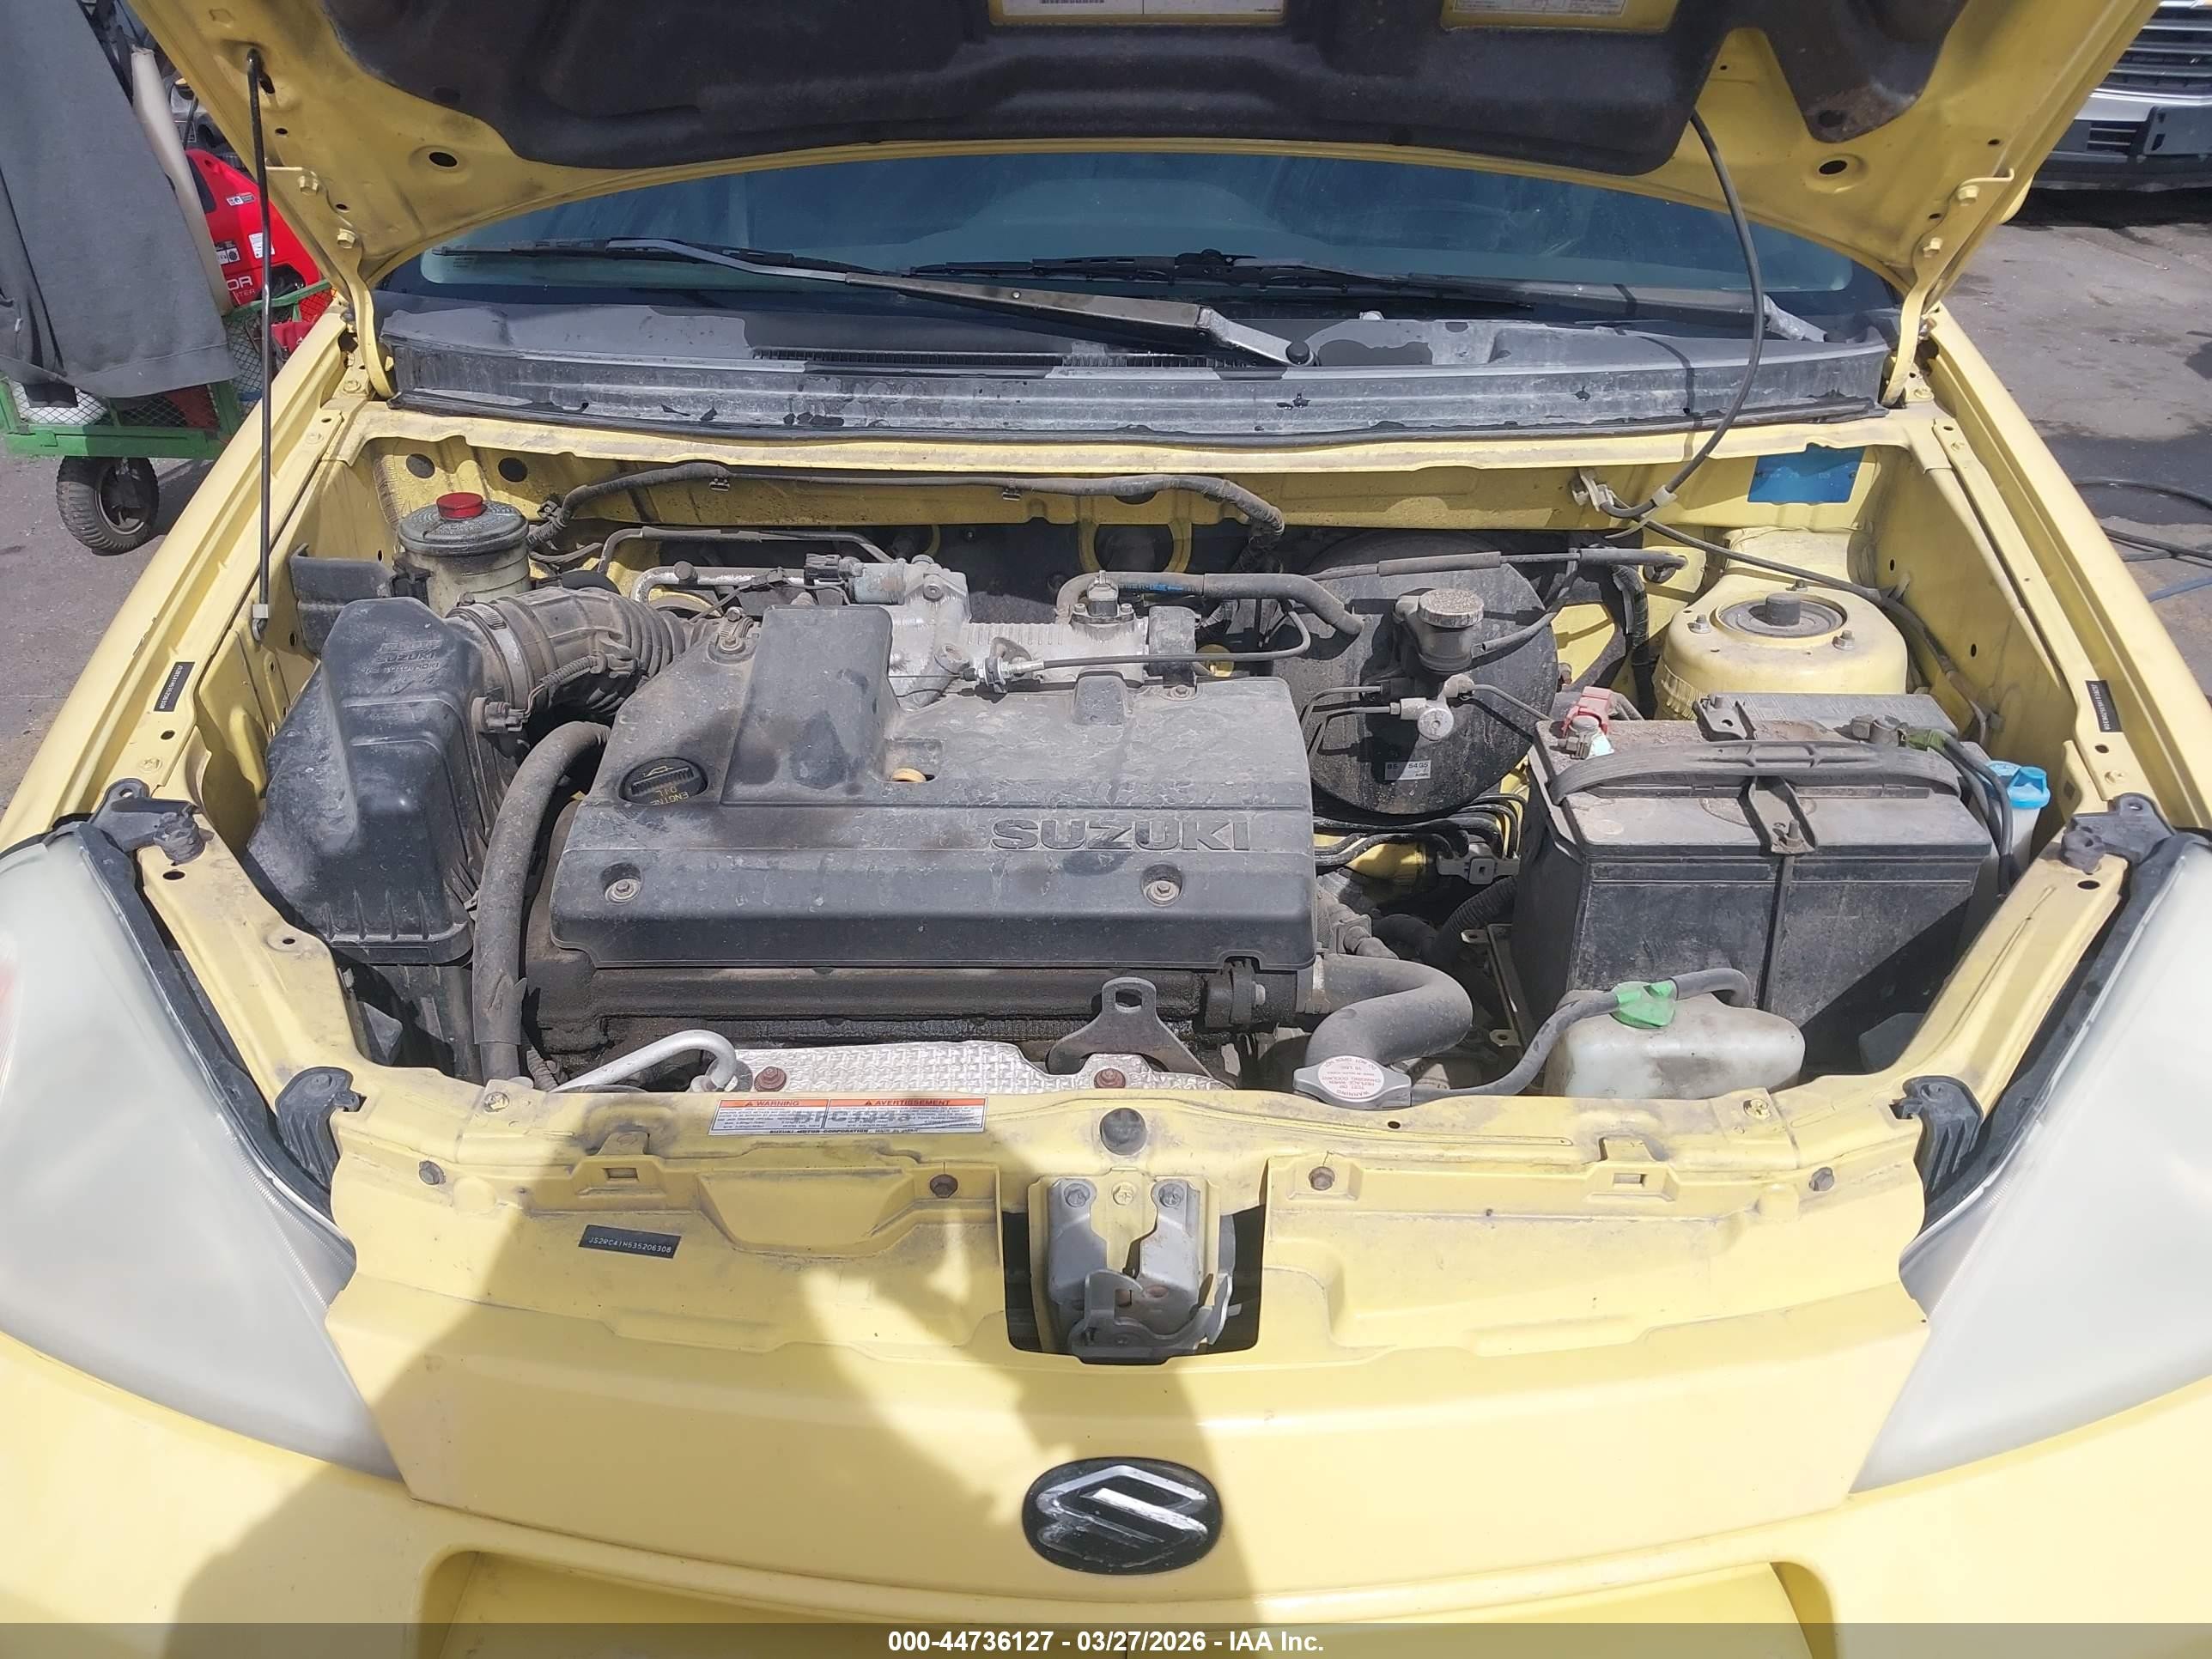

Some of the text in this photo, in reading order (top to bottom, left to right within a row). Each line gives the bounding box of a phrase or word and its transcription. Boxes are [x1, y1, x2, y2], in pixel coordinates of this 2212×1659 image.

[650, 791, 689, 805] ENGINE
[655, 786, 678, 797] OIL
[990, 818, 1250, 851] SUZUKI
